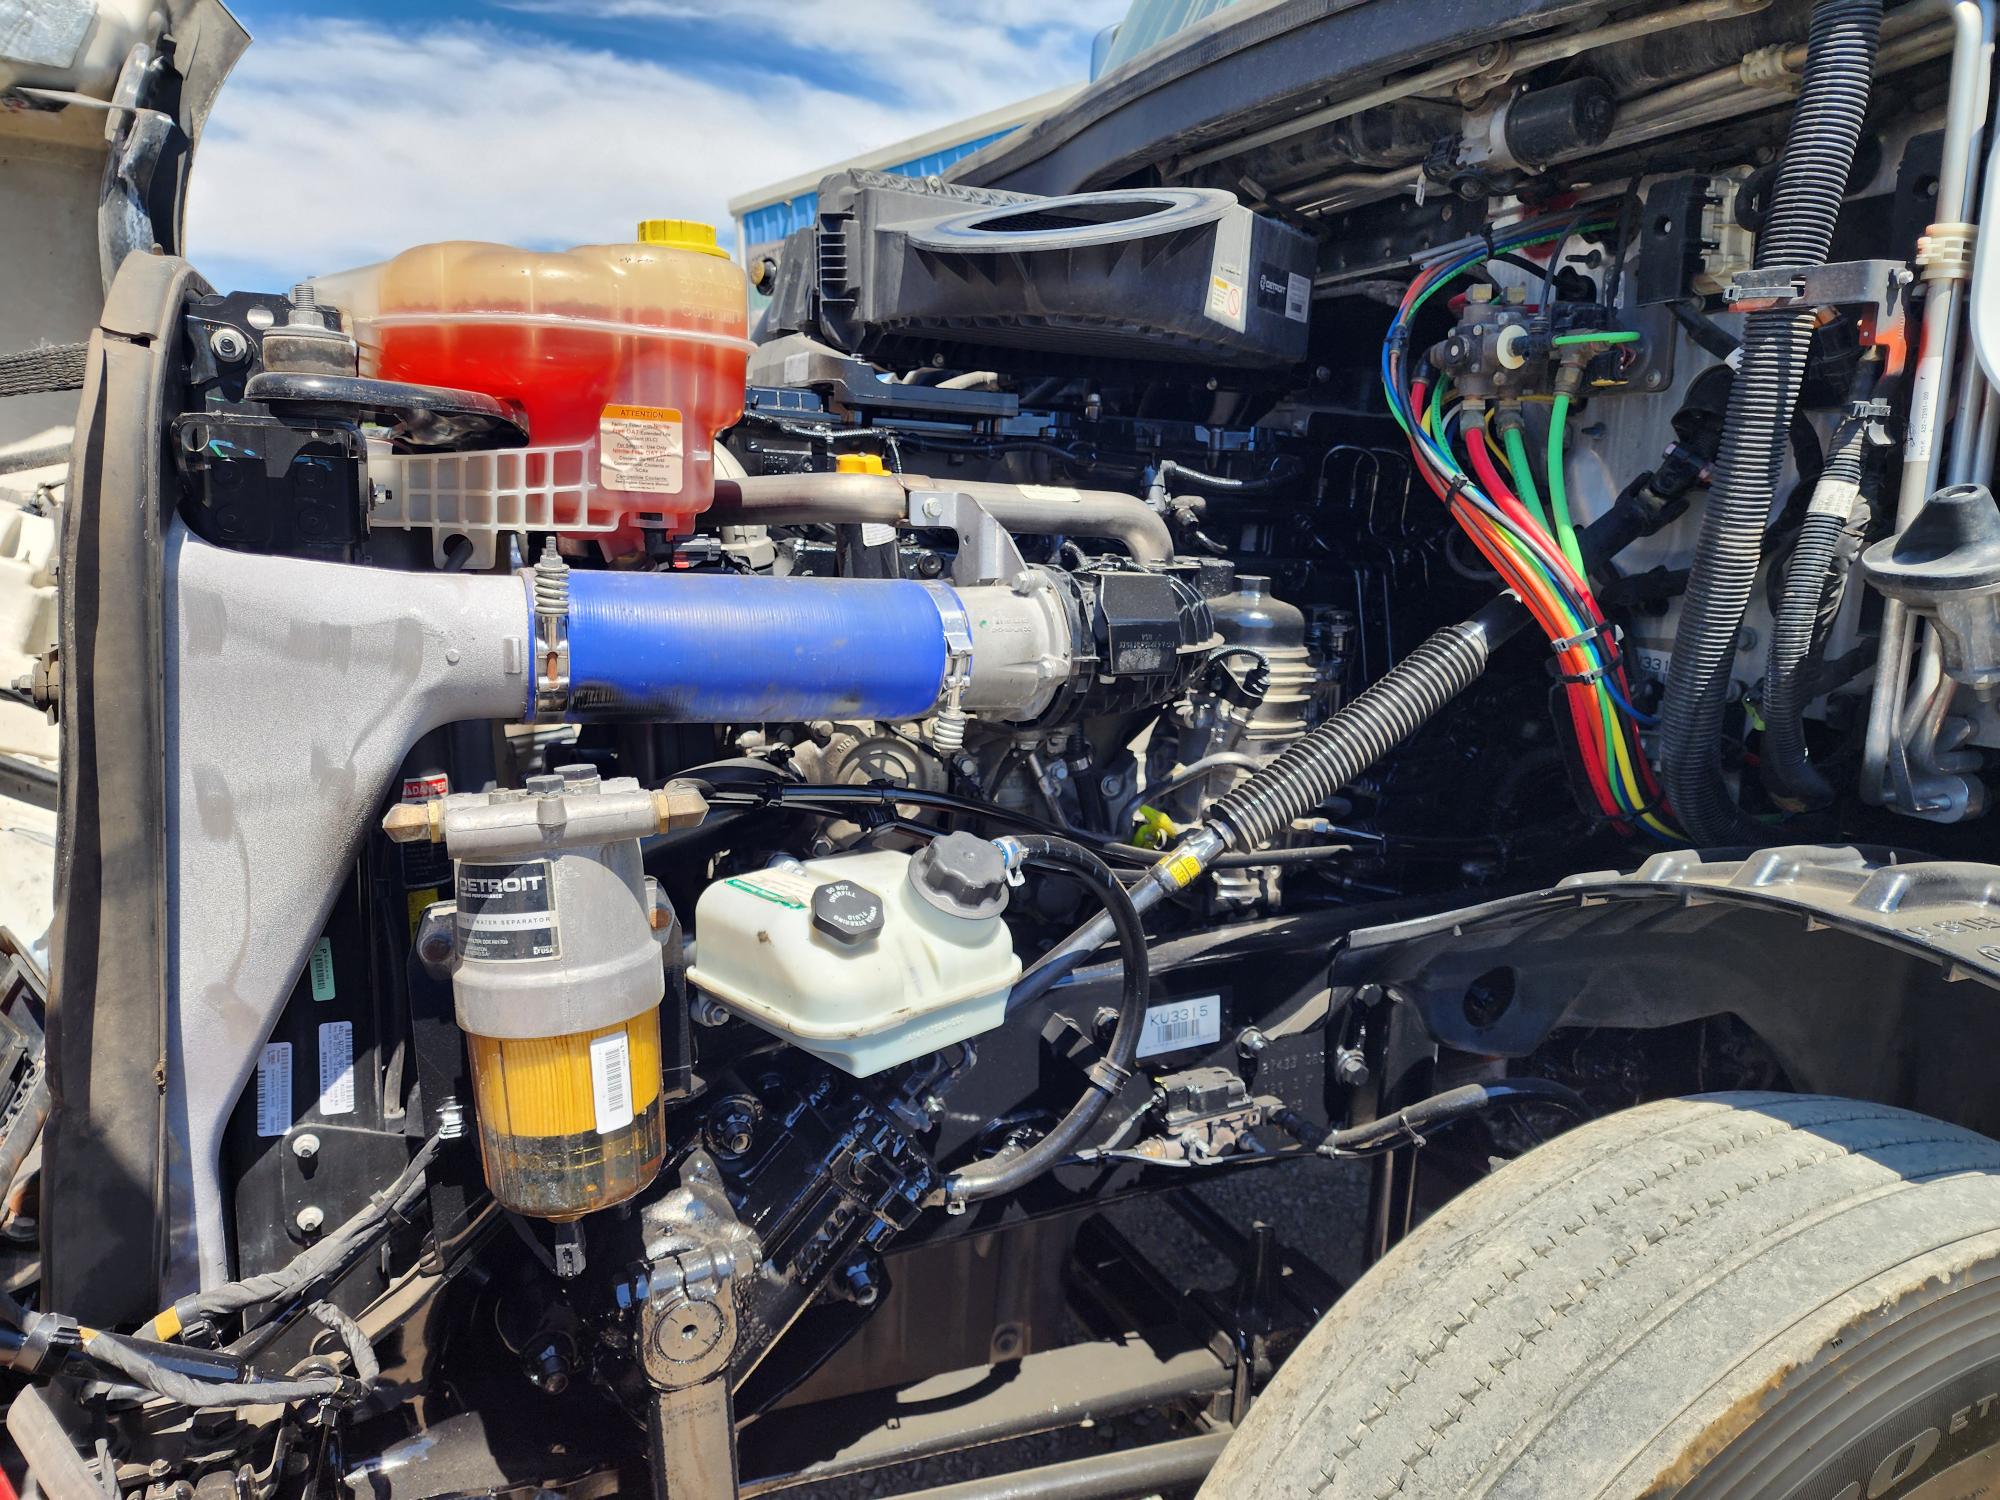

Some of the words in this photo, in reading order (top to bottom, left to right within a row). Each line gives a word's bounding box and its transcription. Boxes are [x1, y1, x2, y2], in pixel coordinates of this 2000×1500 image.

[621, 410, 664, 418] ATTENTION
[459, 876, 542, 892] DETROIT
[501, 916, 550, 926] SEPARATOR
[1150, 1004, 1208, 1026] KU3315
